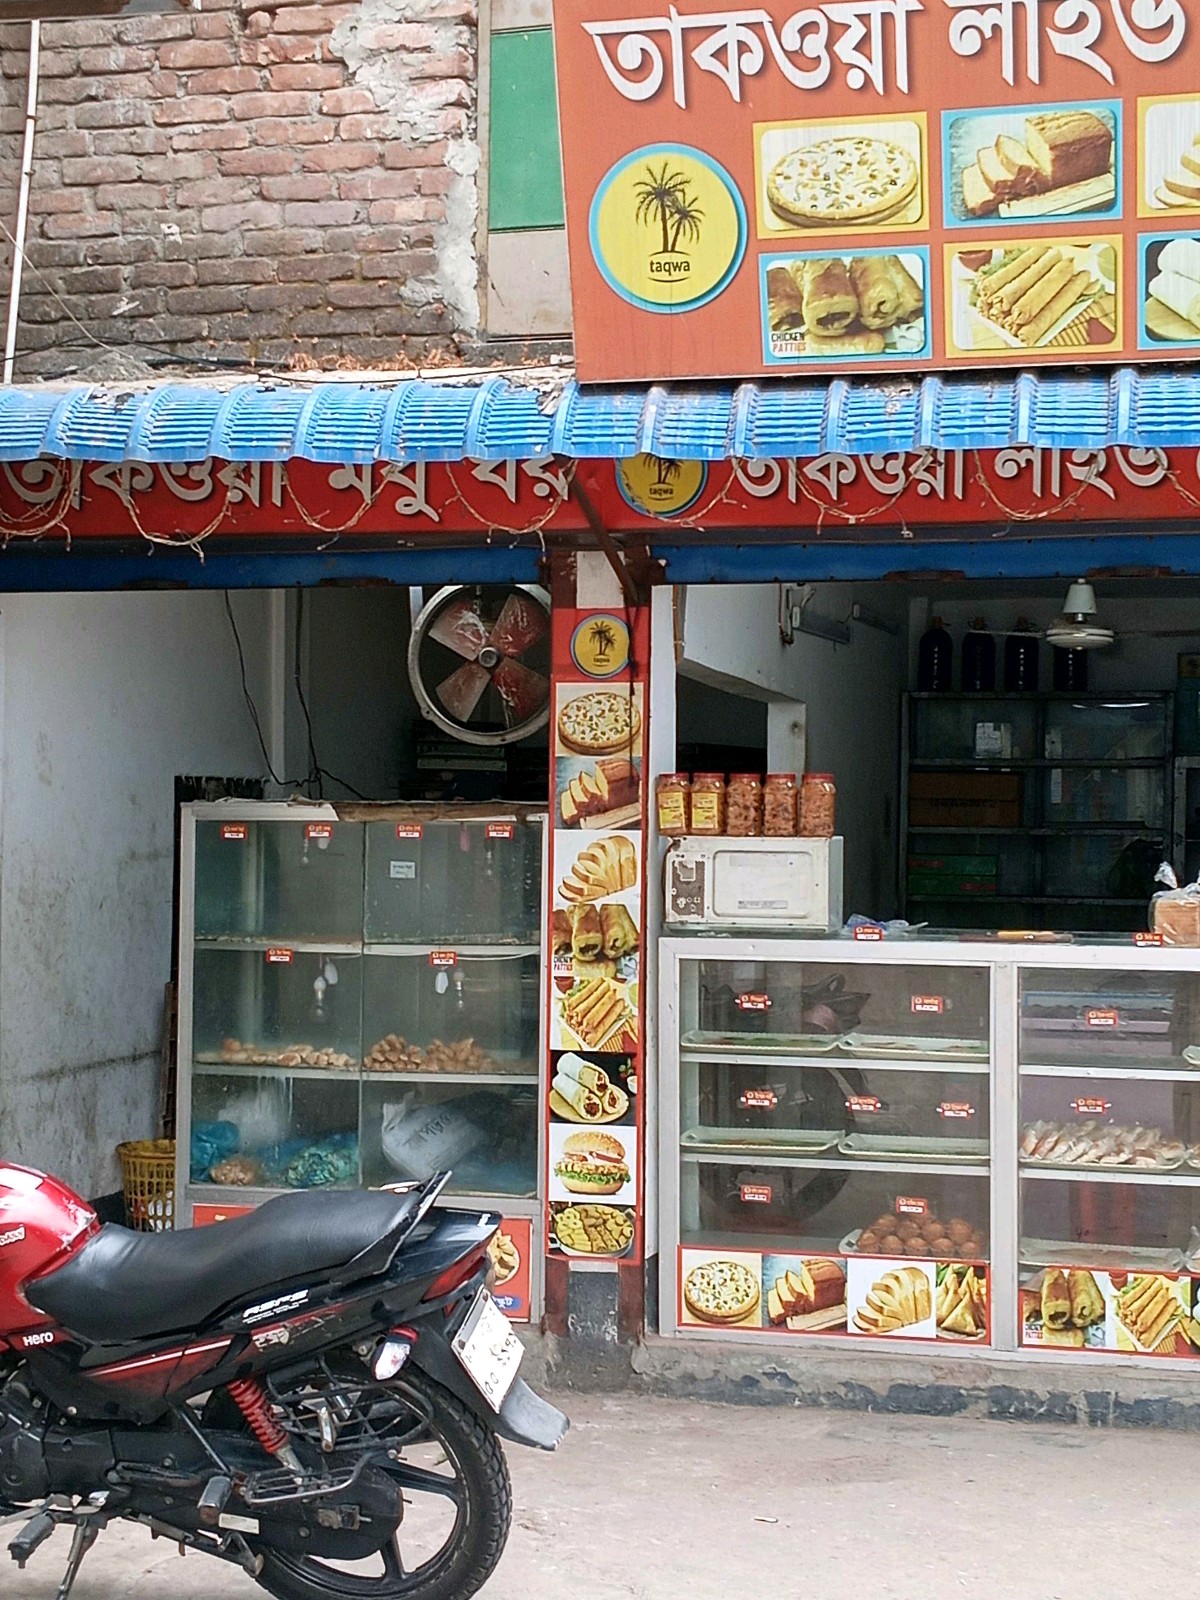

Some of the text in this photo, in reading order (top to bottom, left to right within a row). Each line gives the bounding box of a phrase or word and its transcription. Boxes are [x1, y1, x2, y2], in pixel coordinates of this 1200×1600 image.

[580, 0, 925, 109] তাকওয়া
[649, 259, 691, 276] taqwa
[771, 331, 806, 342] CHICKEN
[772, 341, 806, 353] PATTIES
